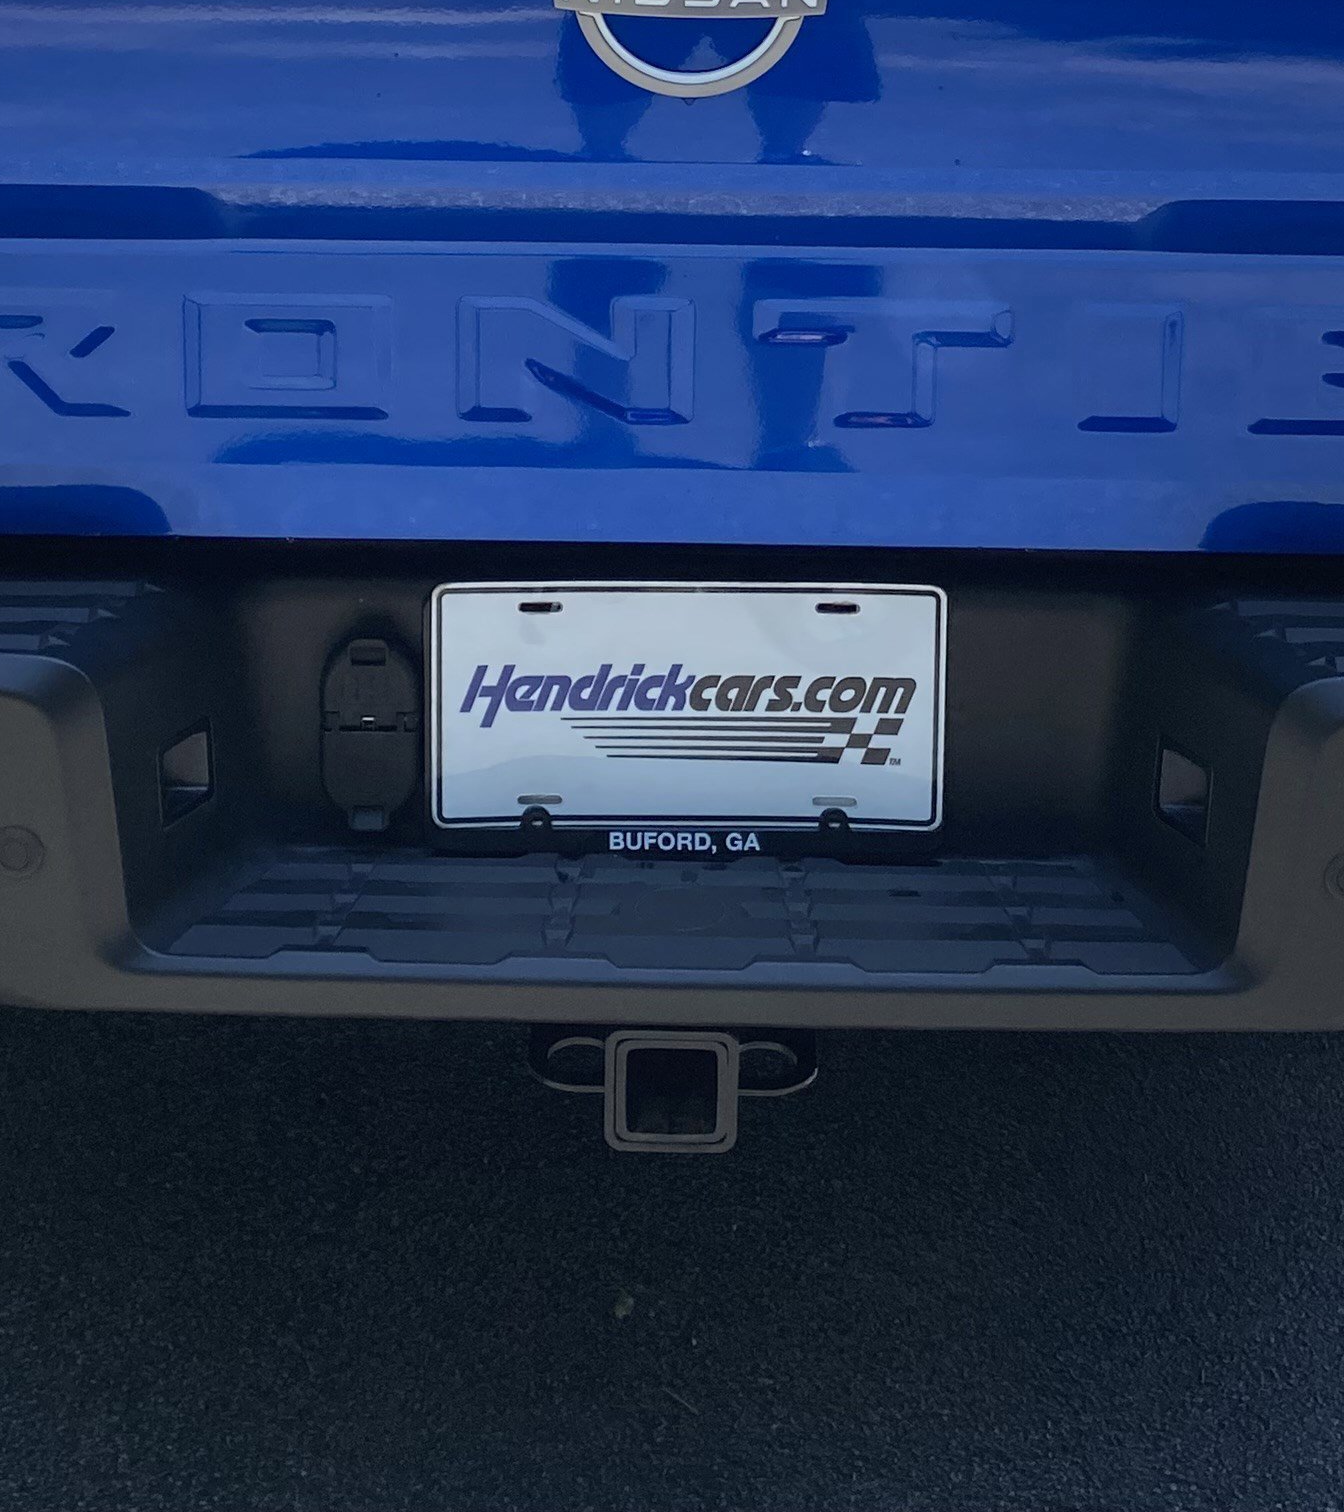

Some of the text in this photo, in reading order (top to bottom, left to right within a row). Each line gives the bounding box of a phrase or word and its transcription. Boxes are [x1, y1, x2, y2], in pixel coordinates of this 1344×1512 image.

[460, 664, 917, 727] Hendrickcars.com
[609, 832, 760, 854] BUFORD, GA
